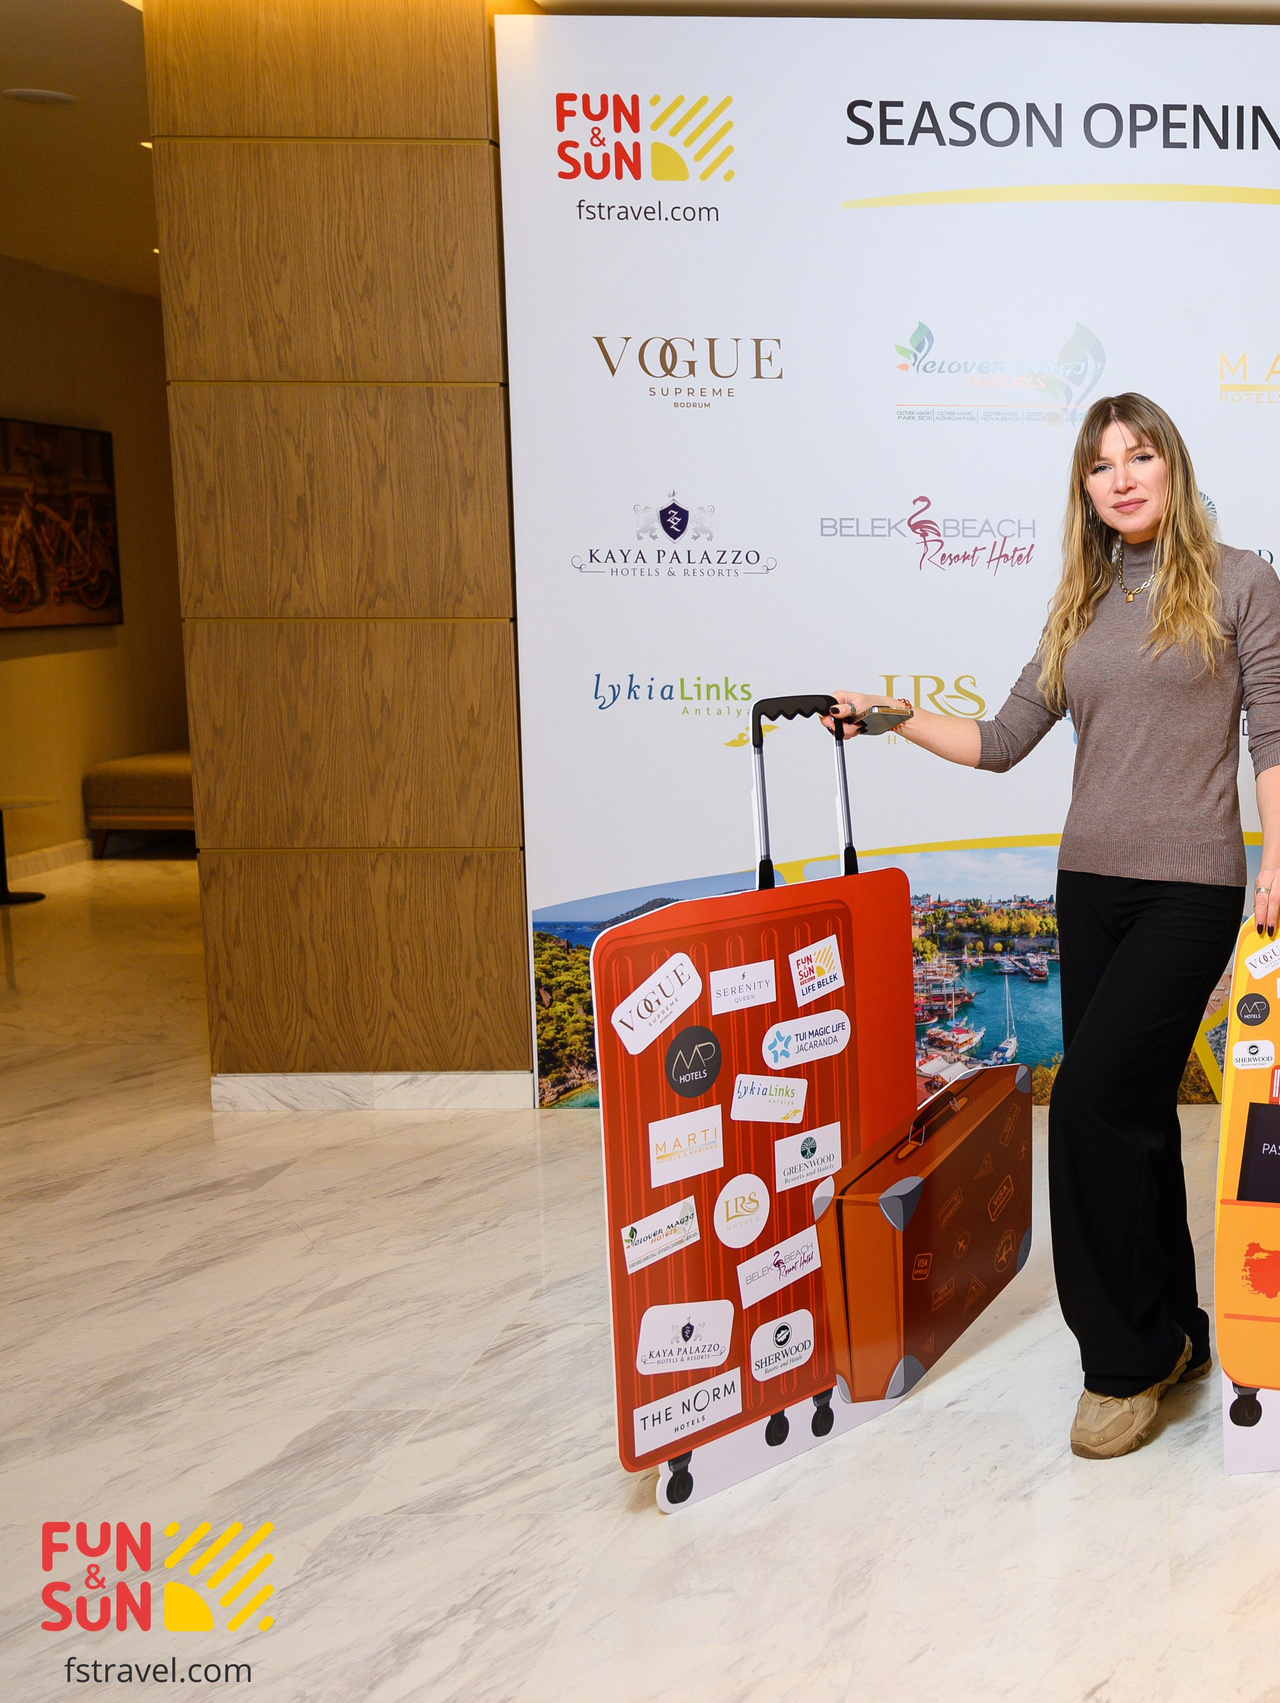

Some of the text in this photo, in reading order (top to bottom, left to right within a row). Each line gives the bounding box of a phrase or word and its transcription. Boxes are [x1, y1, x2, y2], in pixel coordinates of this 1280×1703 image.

[555, 92, 641, 133] FUN
[846, 99, 1063, 148] SEASON
[589, 126, 607, 147] &
[557, 140, 642, 181] SUN
[576, 199, 720, 222] fstravel.com
[592, 335, 784, 380] VOGUE
[922, 359, 1103, 376] CLOVER MAGIC
[648, 386, 736, 398] SUPREME
[967, 375, 1047, 389] HOTELS
[819, 517, 1036, 538] BELEK BEACH
[589, 549, 761, 565] KAYA PALAZZO
[916, 536, 1035, 576] Resort Hotel
[610, 567, 740, 577] HOTELS & RESORTS
[796, 954, 813, 970] FUN
[715, 978, 771, 998] SERENITY
[801, 972, 839, 997] LIFE BELEK
[618, 962, 691, 1031] VOGUE
[734, 994, 755, 1003] QUEEN
[648, 997, 679, 1028] SUPREME
[794, 1021, 846, 1042] TUI MAGIC LIFE
[795, 1035, 839, 1054] JACARANDA
[679, 1069, 708, 1084] HOTELS
[655, 1126, 718, 1156] MARTI
[783, 1153, 835, 1177] GREENWOOD
[993, 1185, 1008, 1206] VISA
[724, 1191, 760, 1223] LRS
[726, 1216, 759, 1231] HOTELS
[745, 1241, 814, 1285] BELEK BEACH
[648, 1343, 720, 1359] KAYA PALAZZO
[754, 1340, 811, 1371] SHERWOOD
[640, 1380, 736, 1431] THE NORM
[674, 1415, 706, 1433] HOTELS
